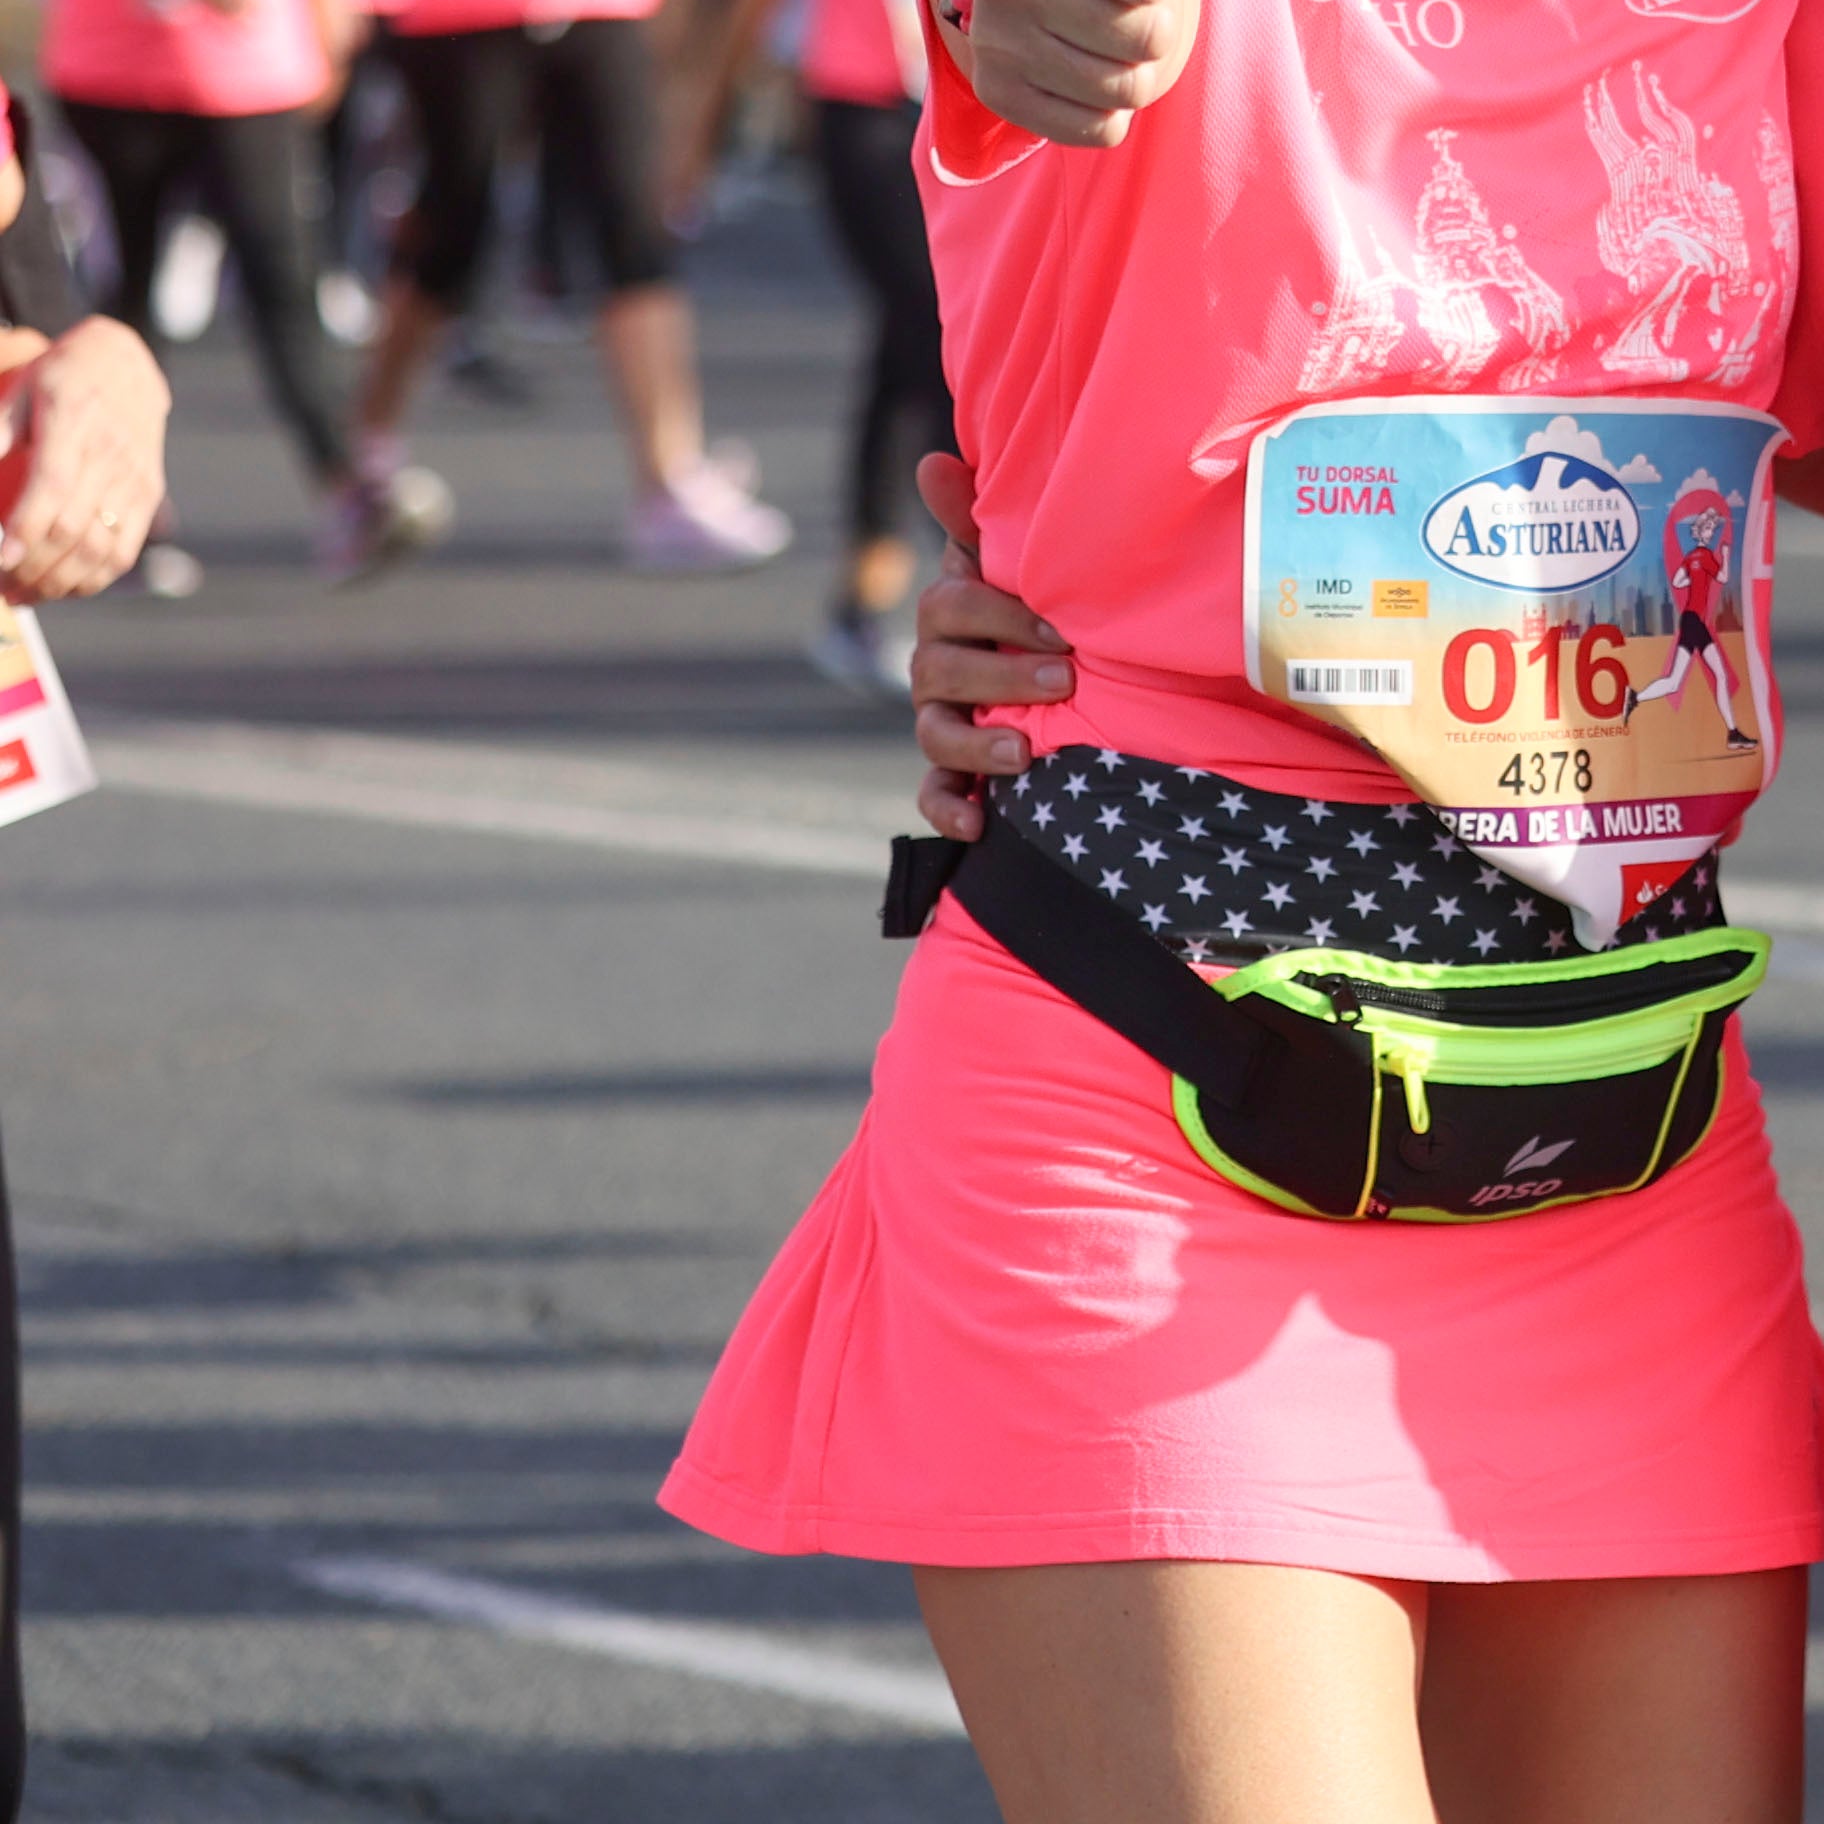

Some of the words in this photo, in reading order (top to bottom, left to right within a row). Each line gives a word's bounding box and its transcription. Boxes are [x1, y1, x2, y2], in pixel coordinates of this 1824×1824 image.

[1296, 465, 1320, 482] TU
[1326, 466, 1399, 484] DORSAL
[1296, 486, 1396, 516] SUMA
[1491, 499, 1558, 516] CENTRAL
[1563, 496, 1621, 513] LECHERA
[1443, 504, 1627, 558] ASTURIANA
[1316, 579, 1353, 595] IMD
[1441, 623, 1631, 725] 016
[1445, 732, 1517, 744] TELÉFONO
[1520, 729, 1571, 742] VIOLENCIA
[1572, 728, 1586, 739] DE
[1587, 725, 1631, 738] GÉNERO
[1498, 749, 1593, 797] 4378
[1528, 810, 1561, 843] DE
[1565, 808, 1598, 840] LA
[1602, 803, 1684, 838] MUJER
